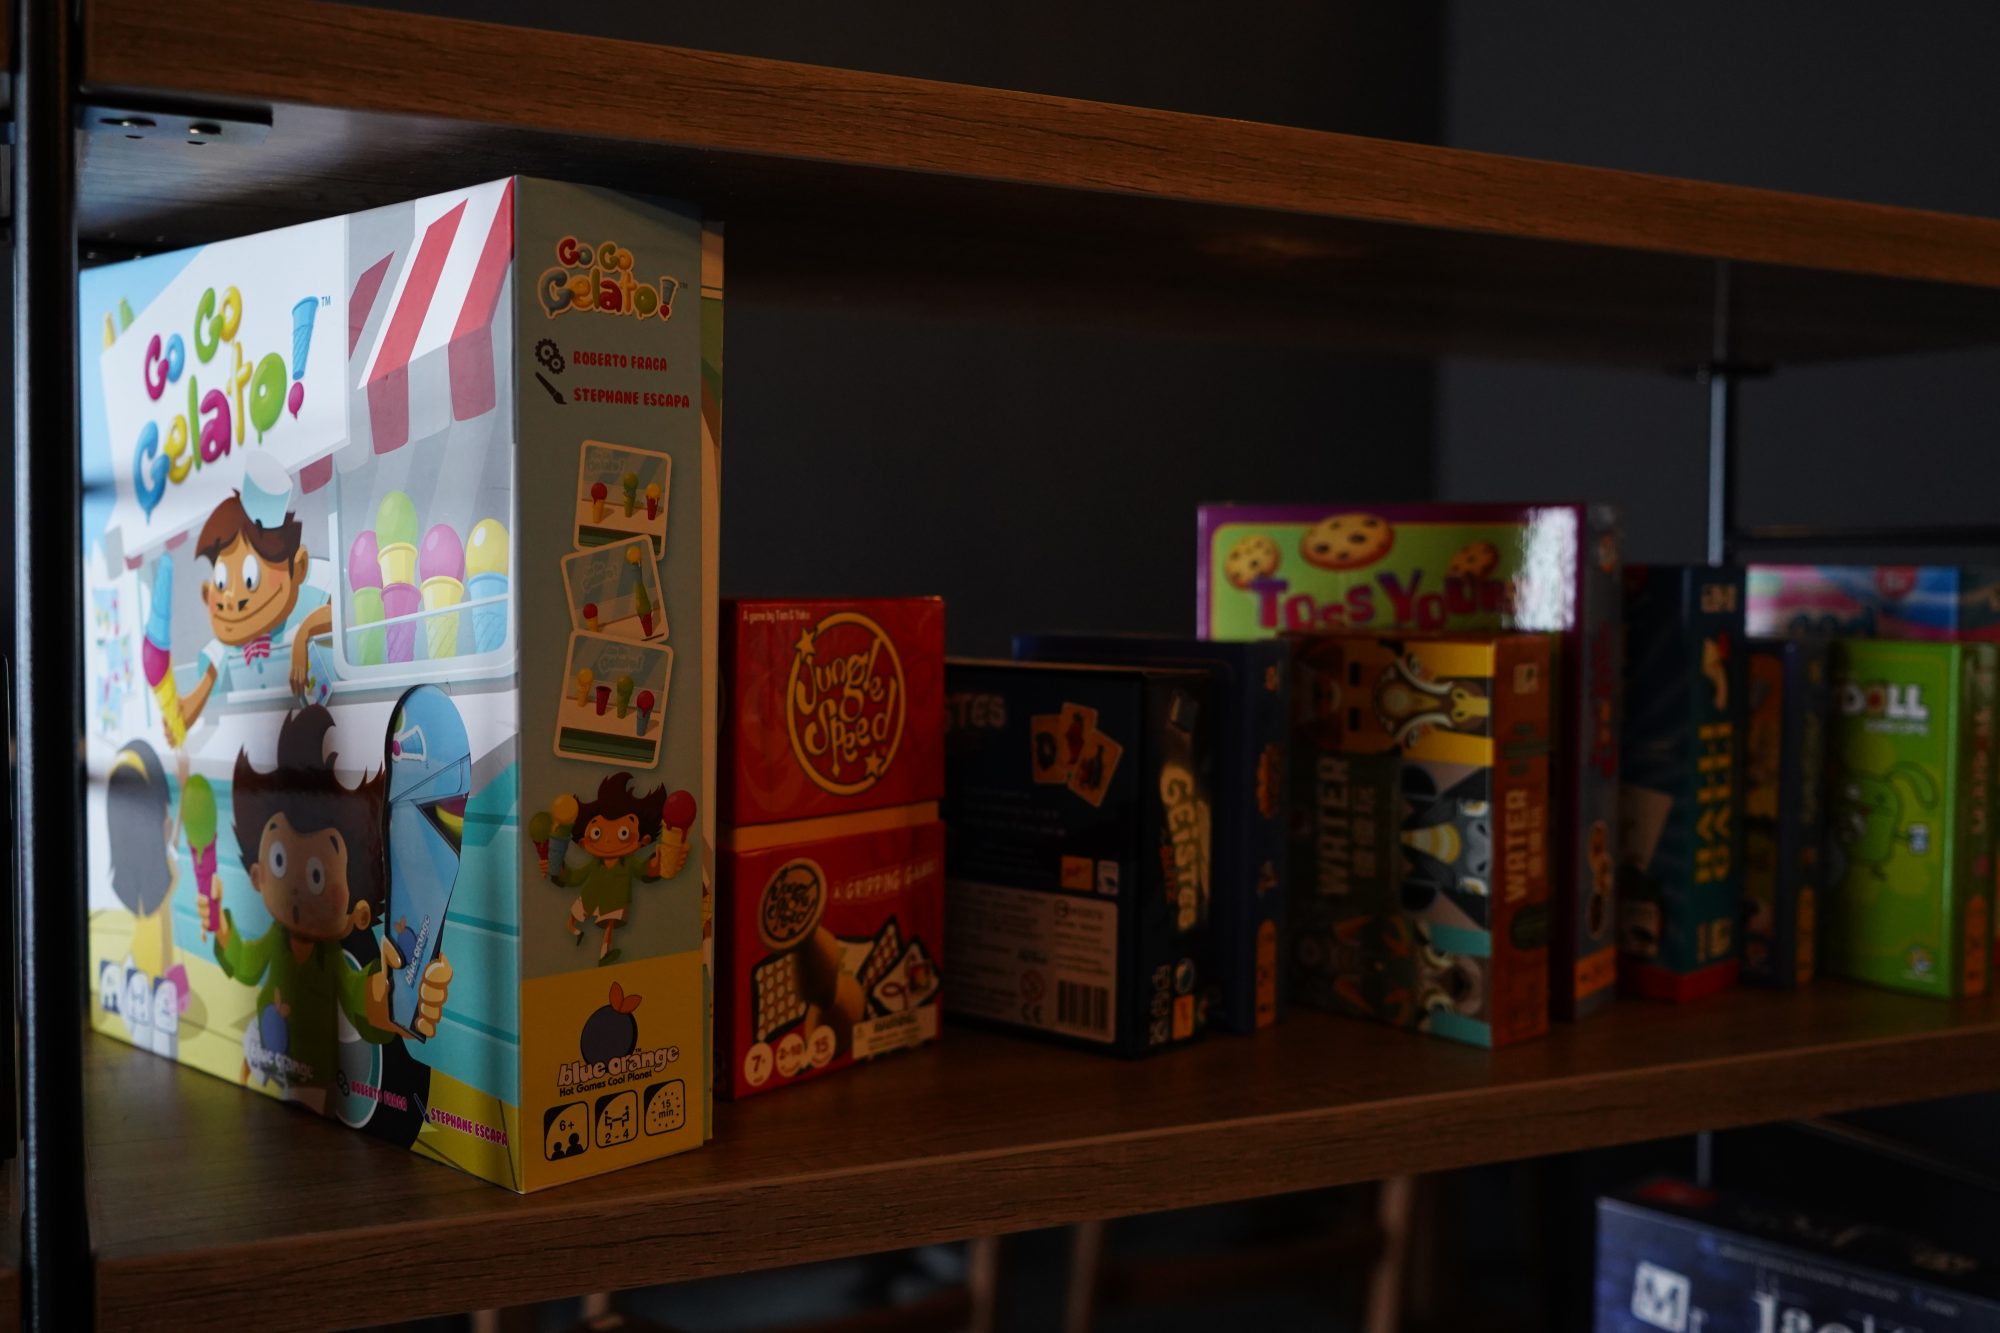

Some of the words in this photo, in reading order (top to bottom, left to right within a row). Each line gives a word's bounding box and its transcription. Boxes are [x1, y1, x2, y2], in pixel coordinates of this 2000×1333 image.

[556, 235, 596, 269] Go
[598, 240, 634, 272] Go
[538, 267, 679, 321] Gelato!
[145, 333, 185, 401] Go
[194, 285, 242, 364] Go
[573, 351, 627, 368] ROBERTO
[631, 356, 668, 371] FRAGA
[133, 296, 319, 525] Gelato!
[574, 388, 640, 405] STEPHANE
[643, 392, 690, 408] ESCAPA
[796, 637, 885, 722] Jungle
[804, 676, 898, 778] Speed
[557, 1061, 607, 1087] blue
[607, 1046, 680, 1073] orange
[559, 1086, 574, 1097] Hot
[576, 1081, 606, 1093] Games
[607, 1074, 625, 1086] Cool
[627, 1070, 653, 1082] Planet
[658, 1109, 674, 1119] min
[660, 1099, 671, 1110] 15
[430, 1108, 473, 1135] STEPHANE
[475, 1123, 508, 1147] ESCAPA
[559, 1120, 575, 1132] 6+
